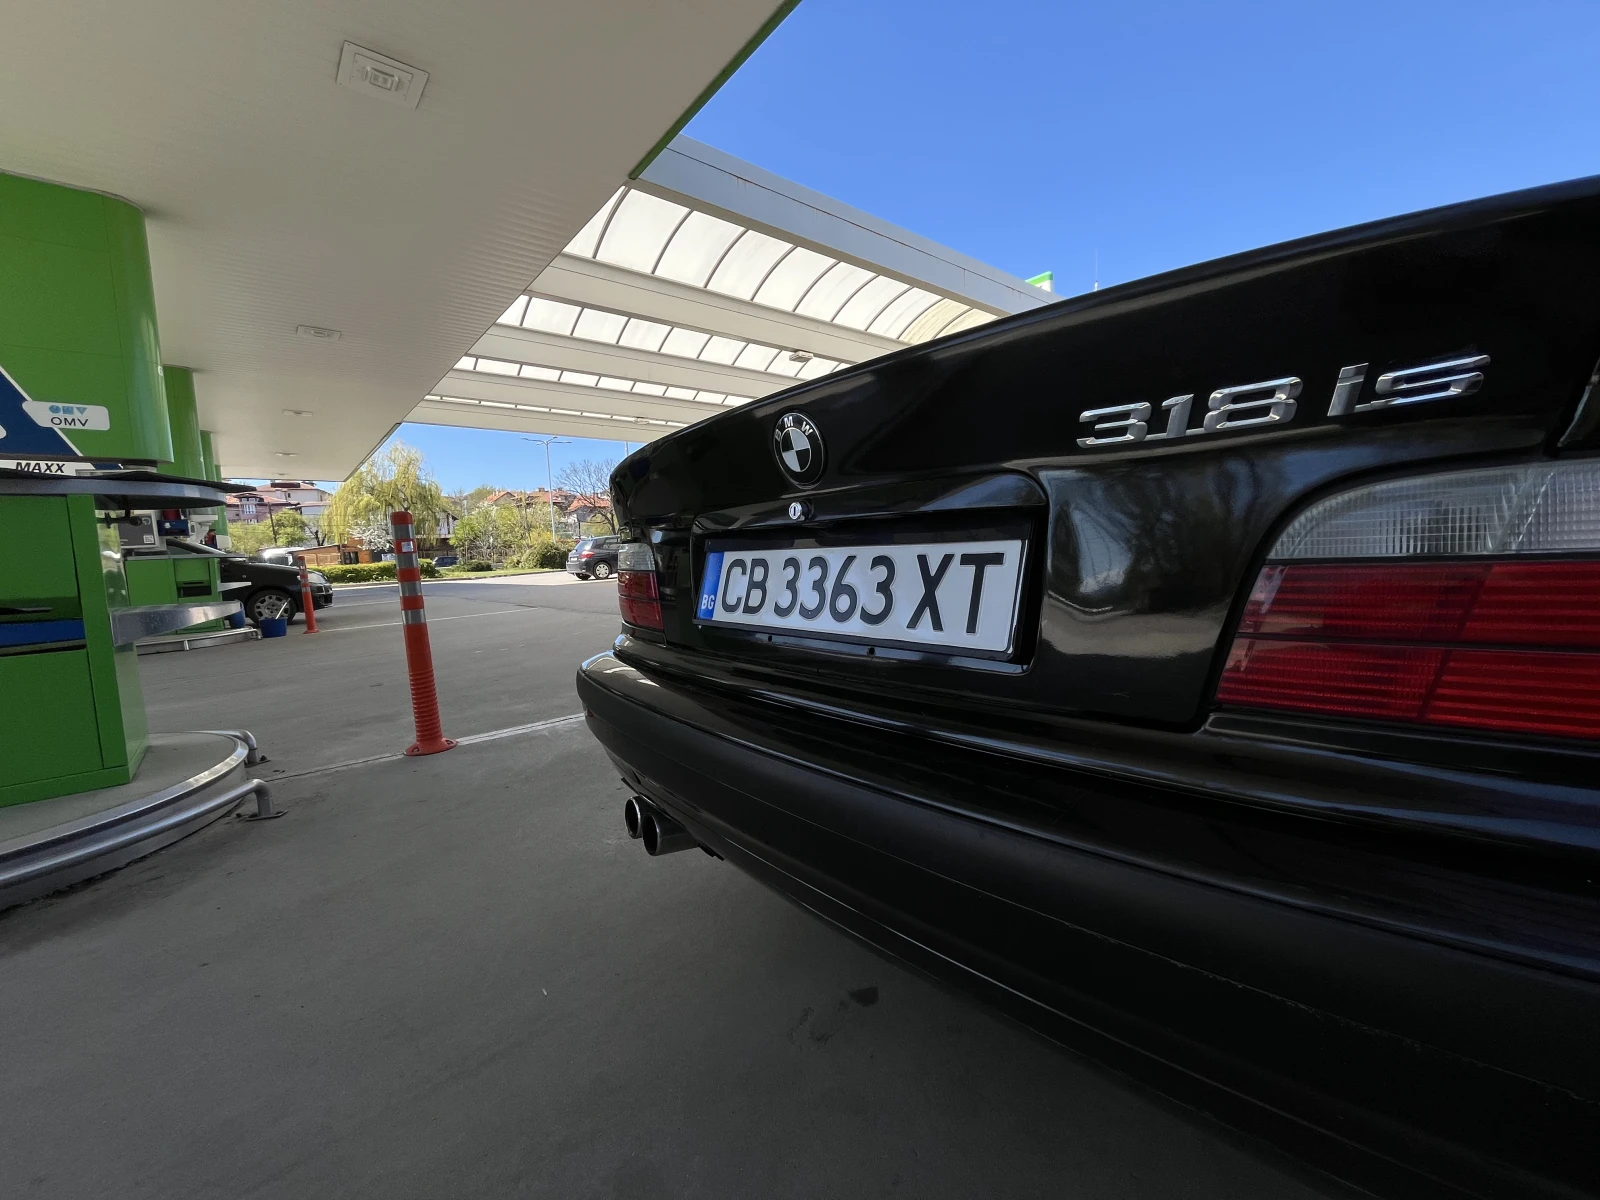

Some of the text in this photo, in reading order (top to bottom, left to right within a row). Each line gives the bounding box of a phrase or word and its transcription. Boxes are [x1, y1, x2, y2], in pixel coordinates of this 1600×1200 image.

[1076, 376, 1303, 448] 318
[50, 416, 88, 427] OMV
[774, 415, 814, 442] BMW
[15, 461, 65, 474] MAXX
[701, 594, 715, 610] BG
